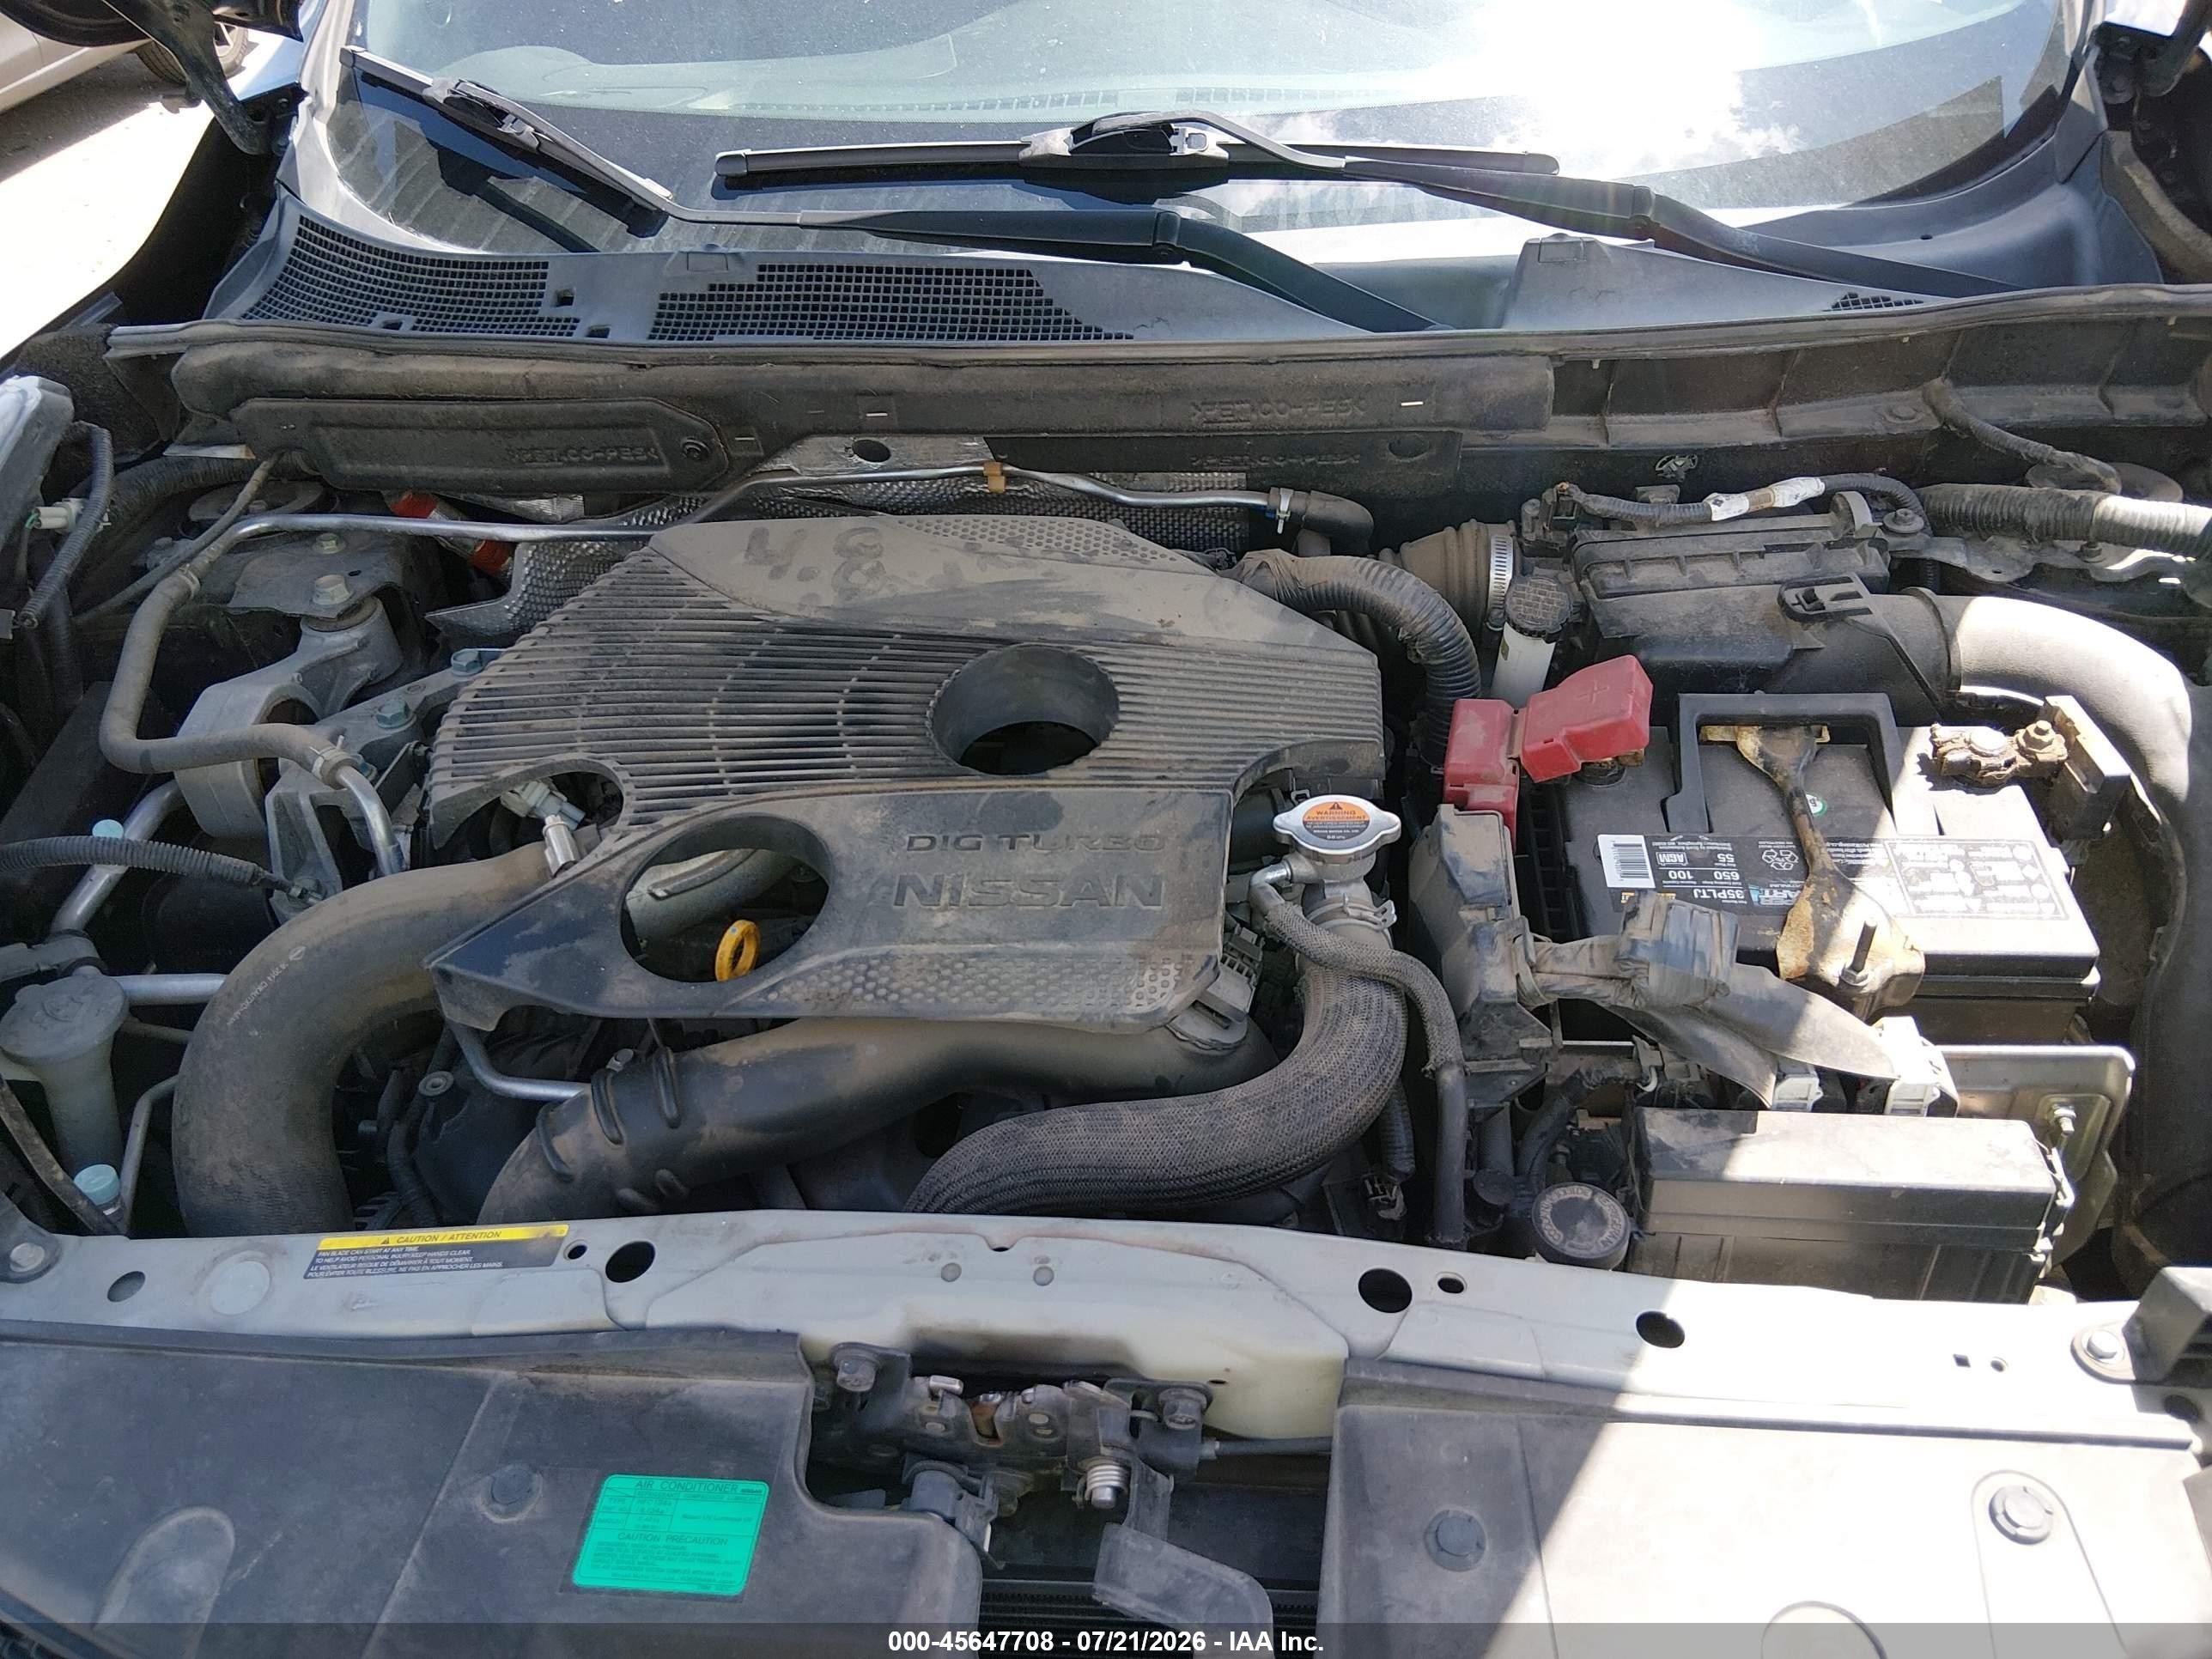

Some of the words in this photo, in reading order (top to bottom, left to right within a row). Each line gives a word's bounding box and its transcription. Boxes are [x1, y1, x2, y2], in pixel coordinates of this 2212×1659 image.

[906, 834, 984, 852] DIG
[997, 834, 1166, 852] TURBO
[1658, 853, 1684, 863] AGM
[1717, 853, 1735, 862] 55
[1668, 870, 1693, 879] 100
[1713, 871, 1740, 880] 650
[892, 872, 1164, 908] NISSAN
[1693, 888, 1745, 899] 35PLTJ
[1759, 890, 1802, 898] ART
[1760, 897, 1795, 906] PER
[397, 1234, 439, 1244] CAUTION
[447, 1231, 501, 1242] ATTENTION
[635, 1480, 655, 1490] AIR
[659, 1480, 738, 1492] CONDITIONER
[617, 1531, 660, 1542] CAUTION
[665, 1534, 728, 1546] PRECAUTION
